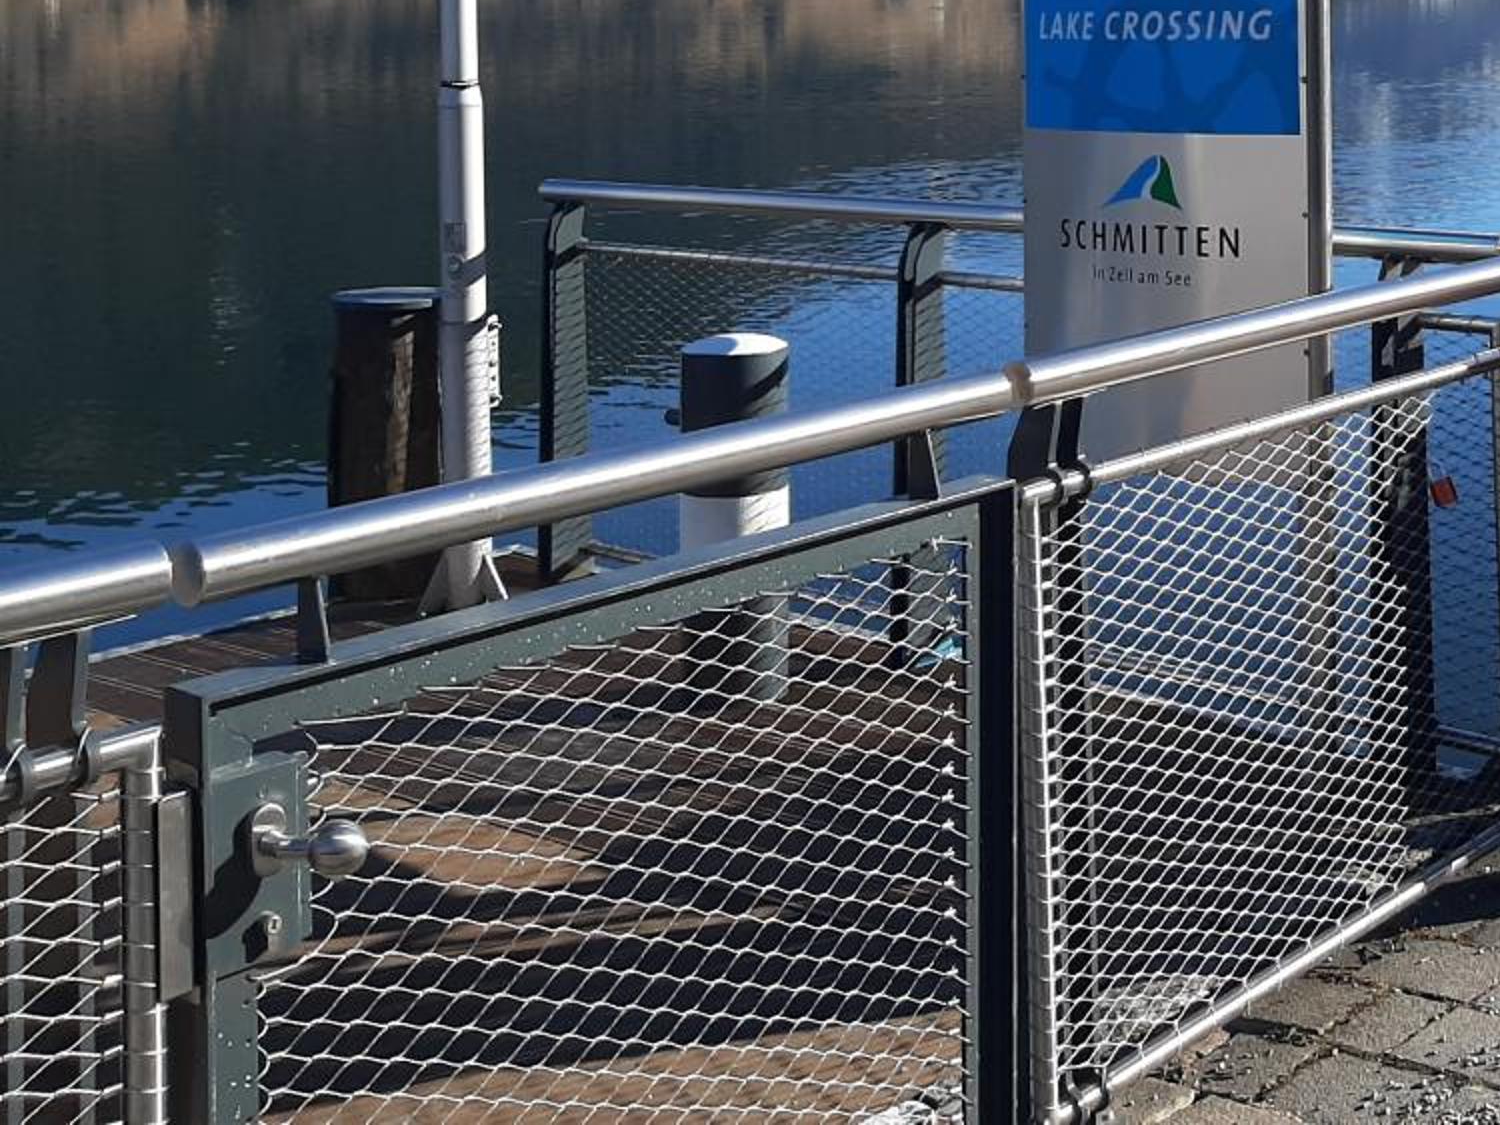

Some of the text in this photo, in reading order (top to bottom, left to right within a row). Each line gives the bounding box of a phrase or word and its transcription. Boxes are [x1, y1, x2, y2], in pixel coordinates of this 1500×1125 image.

[1039, 9, 1273, 41] LAKE CROSSING
[1060, 219, 1240, 258] SCHMITTEN
[1108, 266, 1133, 284] Zell
[1137, 272, 1159, 285] am
[1165, 270, 1192, 287] See
